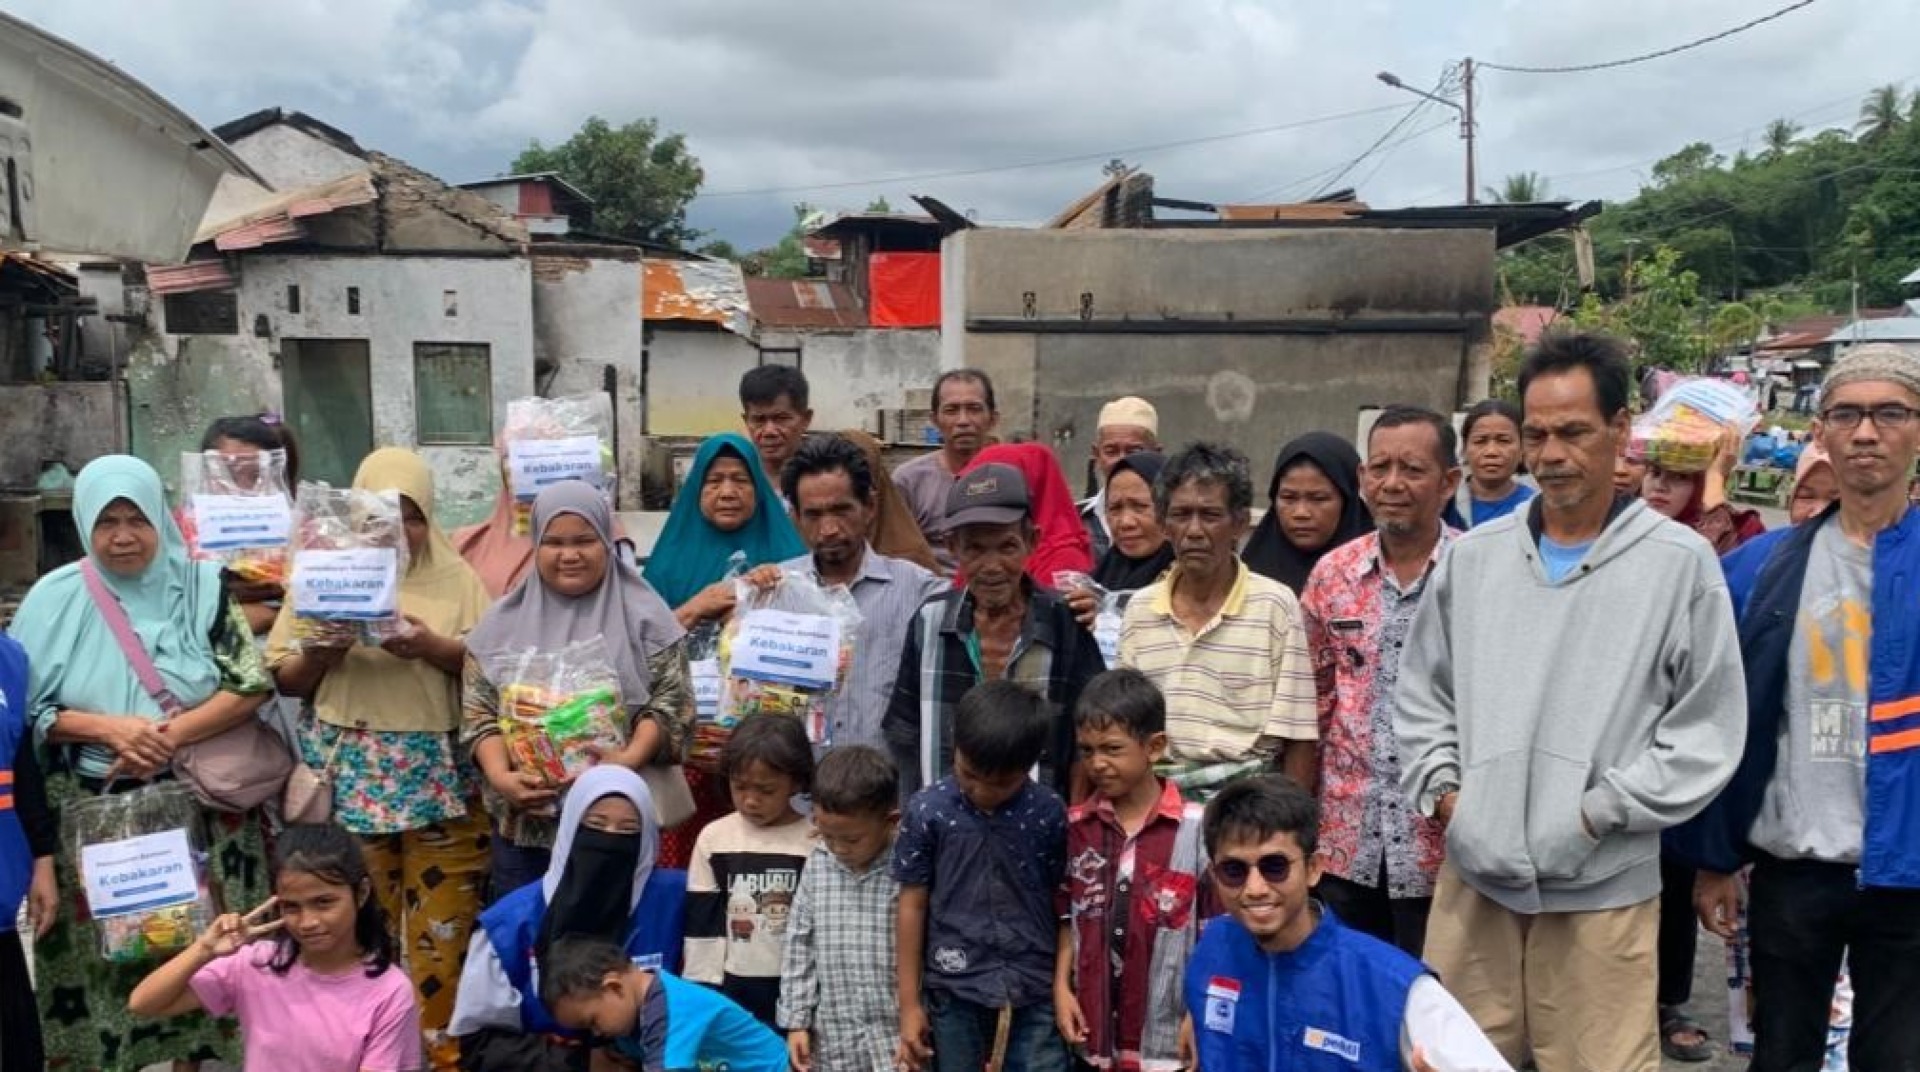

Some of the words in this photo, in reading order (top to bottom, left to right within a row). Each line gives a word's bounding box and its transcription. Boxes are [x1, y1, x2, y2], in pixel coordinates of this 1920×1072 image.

[306, 577, 385, 589] Kebakaran
[750, 637, 828, 656] Kebakaran
[99, 863, 183, 887] Kebakaran
